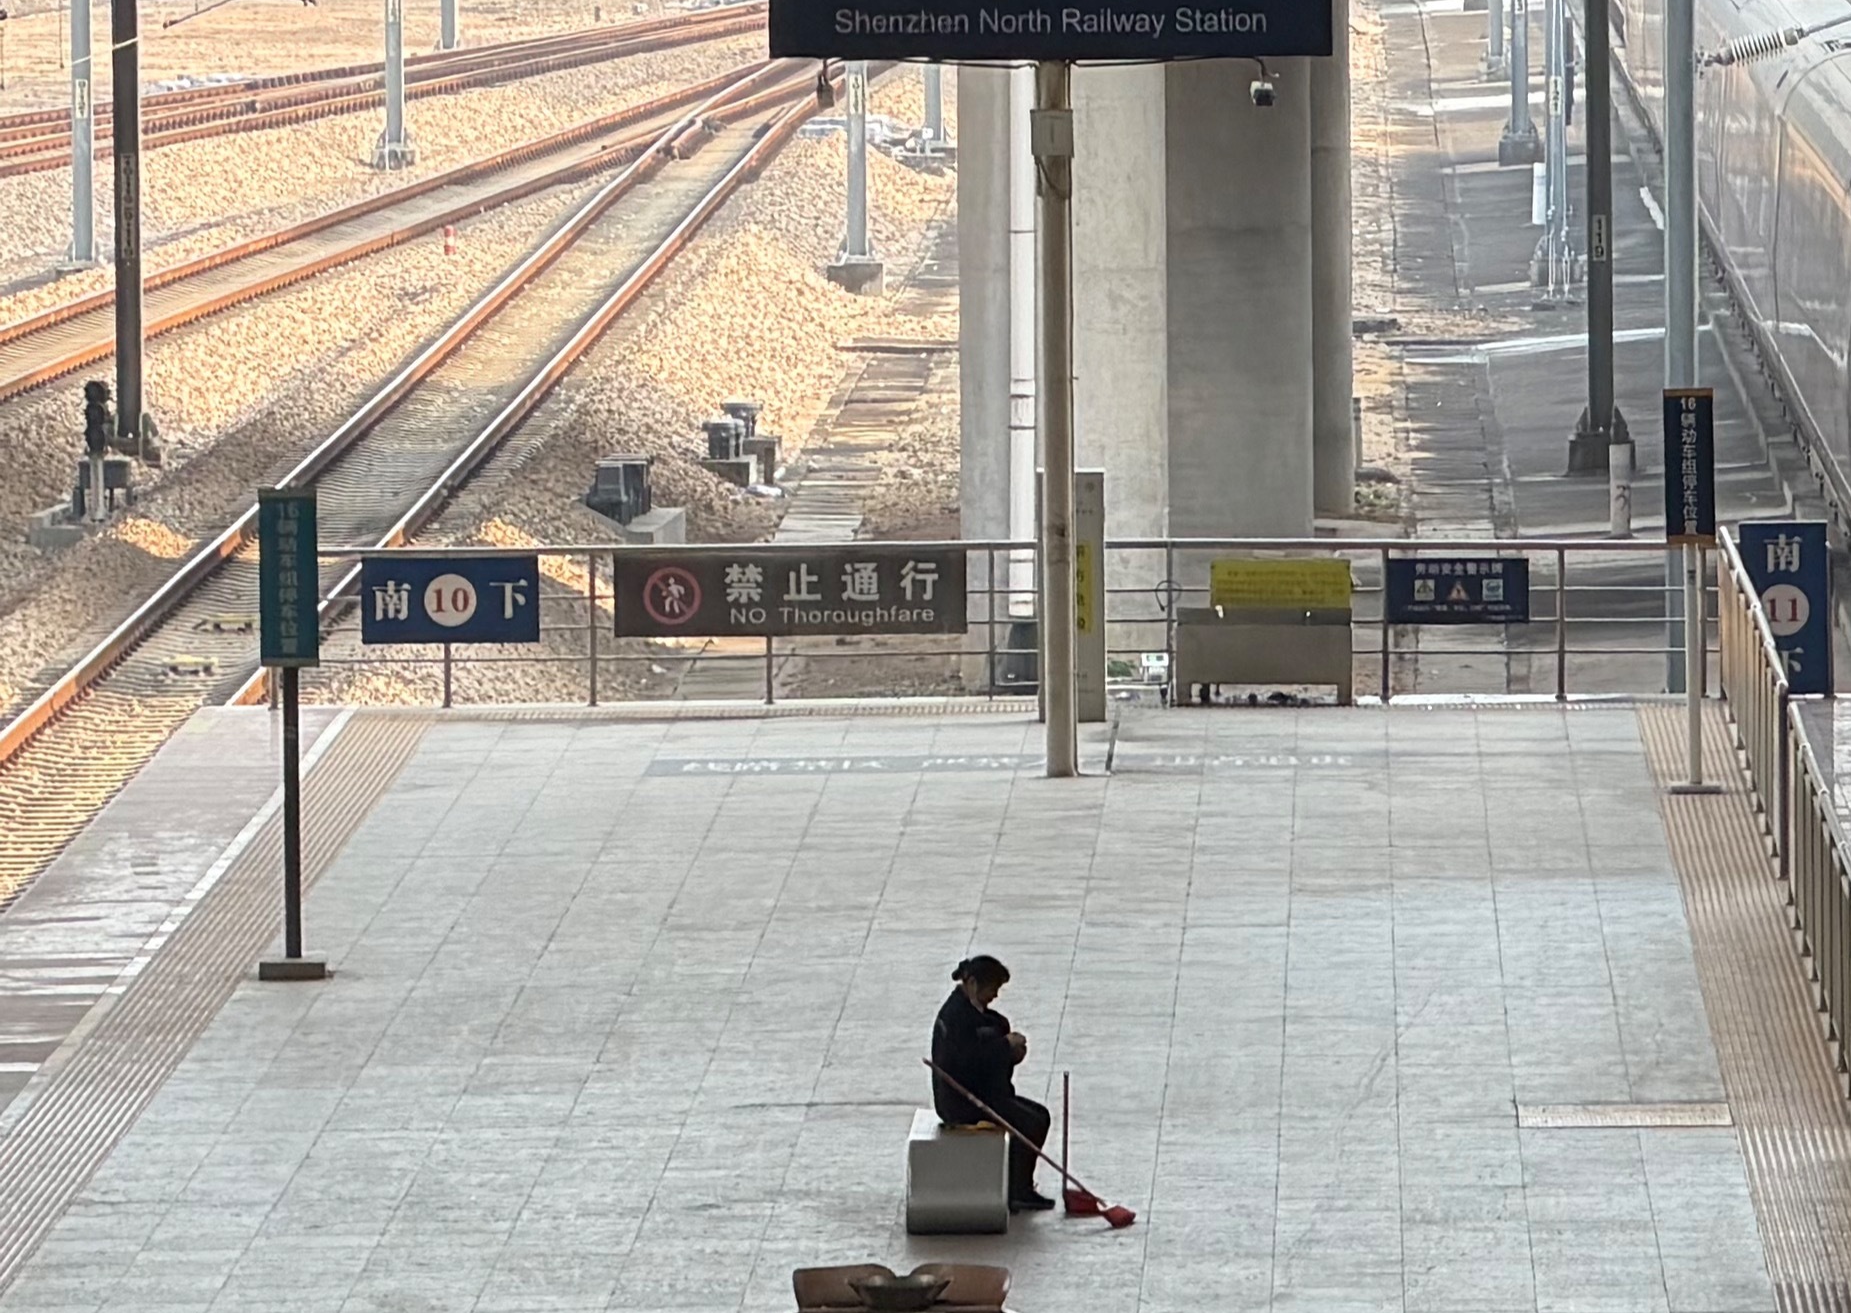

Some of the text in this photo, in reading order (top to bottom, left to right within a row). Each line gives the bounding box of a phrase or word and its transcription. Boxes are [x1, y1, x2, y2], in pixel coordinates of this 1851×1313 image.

[834, 6, 1267, 39] Shenzhen North Railway Station
[1763, 534, 1803, 573] 南
[372, 579, 529, 621] 南 10 下
[723, 560, 939, 604] 禁止通行
[730, 605, 936, 627] NO Thoroughfare
[1767, 597, 1801, 623] 11
